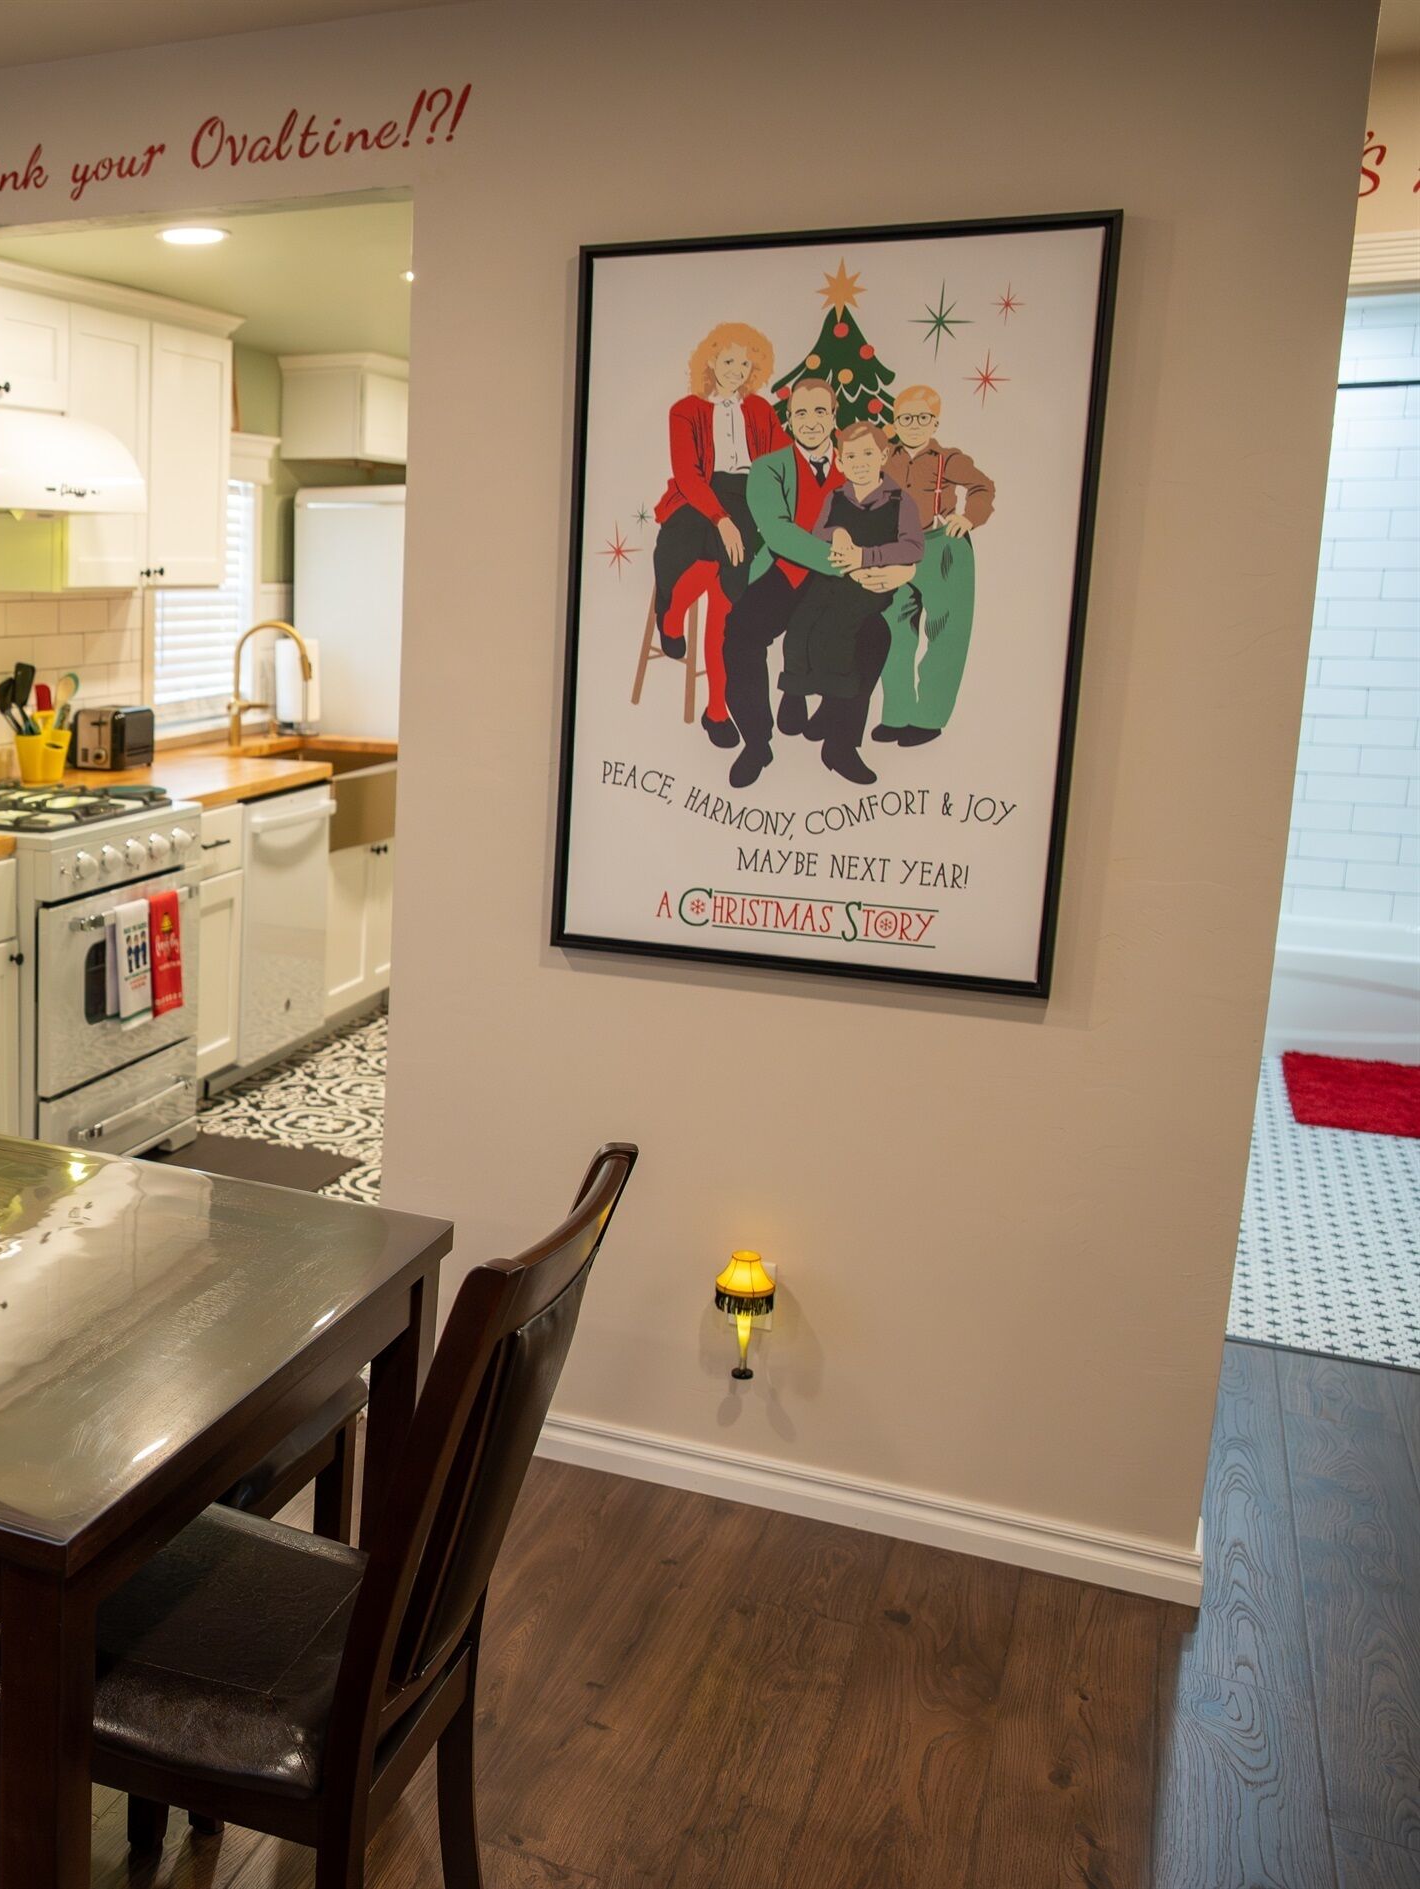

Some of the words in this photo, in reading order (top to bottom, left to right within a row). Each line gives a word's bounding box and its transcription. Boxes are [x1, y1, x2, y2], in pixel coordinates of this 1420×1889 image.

[69, 142, 166, 201] your
[190, 83, 473, 169] Ovaltine!?!
[601, 760, 676, 806] PEACE,
[683, 785, 797, 841] HARMONY,
[805, 789, 930, 835] COMFORT
[941, 791, 953, 817] &
[959, 793, 1018, 826] JOY
[736, 847, 819, 877] MAYBE
[829, 853, 891, 883] NEXT
[899, 859, 970, 890] YEAR!
[655, 890, 672, 919] A
